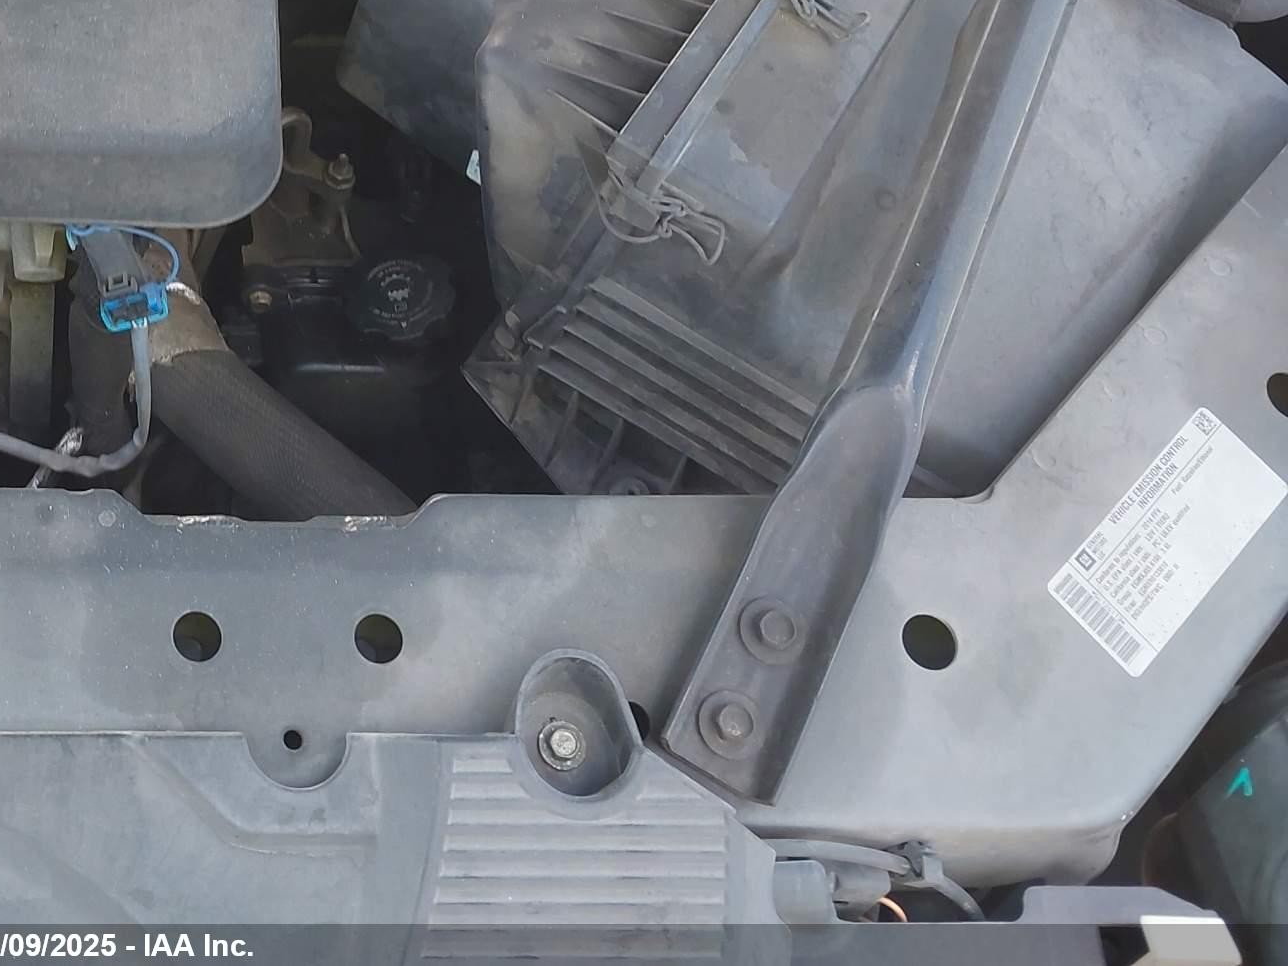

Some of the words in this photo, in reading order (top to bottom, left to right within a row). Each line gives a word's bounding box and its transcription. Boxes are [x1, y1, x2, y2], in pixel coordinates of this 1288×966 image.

[1108, 494, 1136, 526] VEHICLE
[1132, 462, 1164, 499] EMISSION
[1159, 433, 1189, 467] CONTROL
[1137, 461, 1179, 509] INFORMATION
